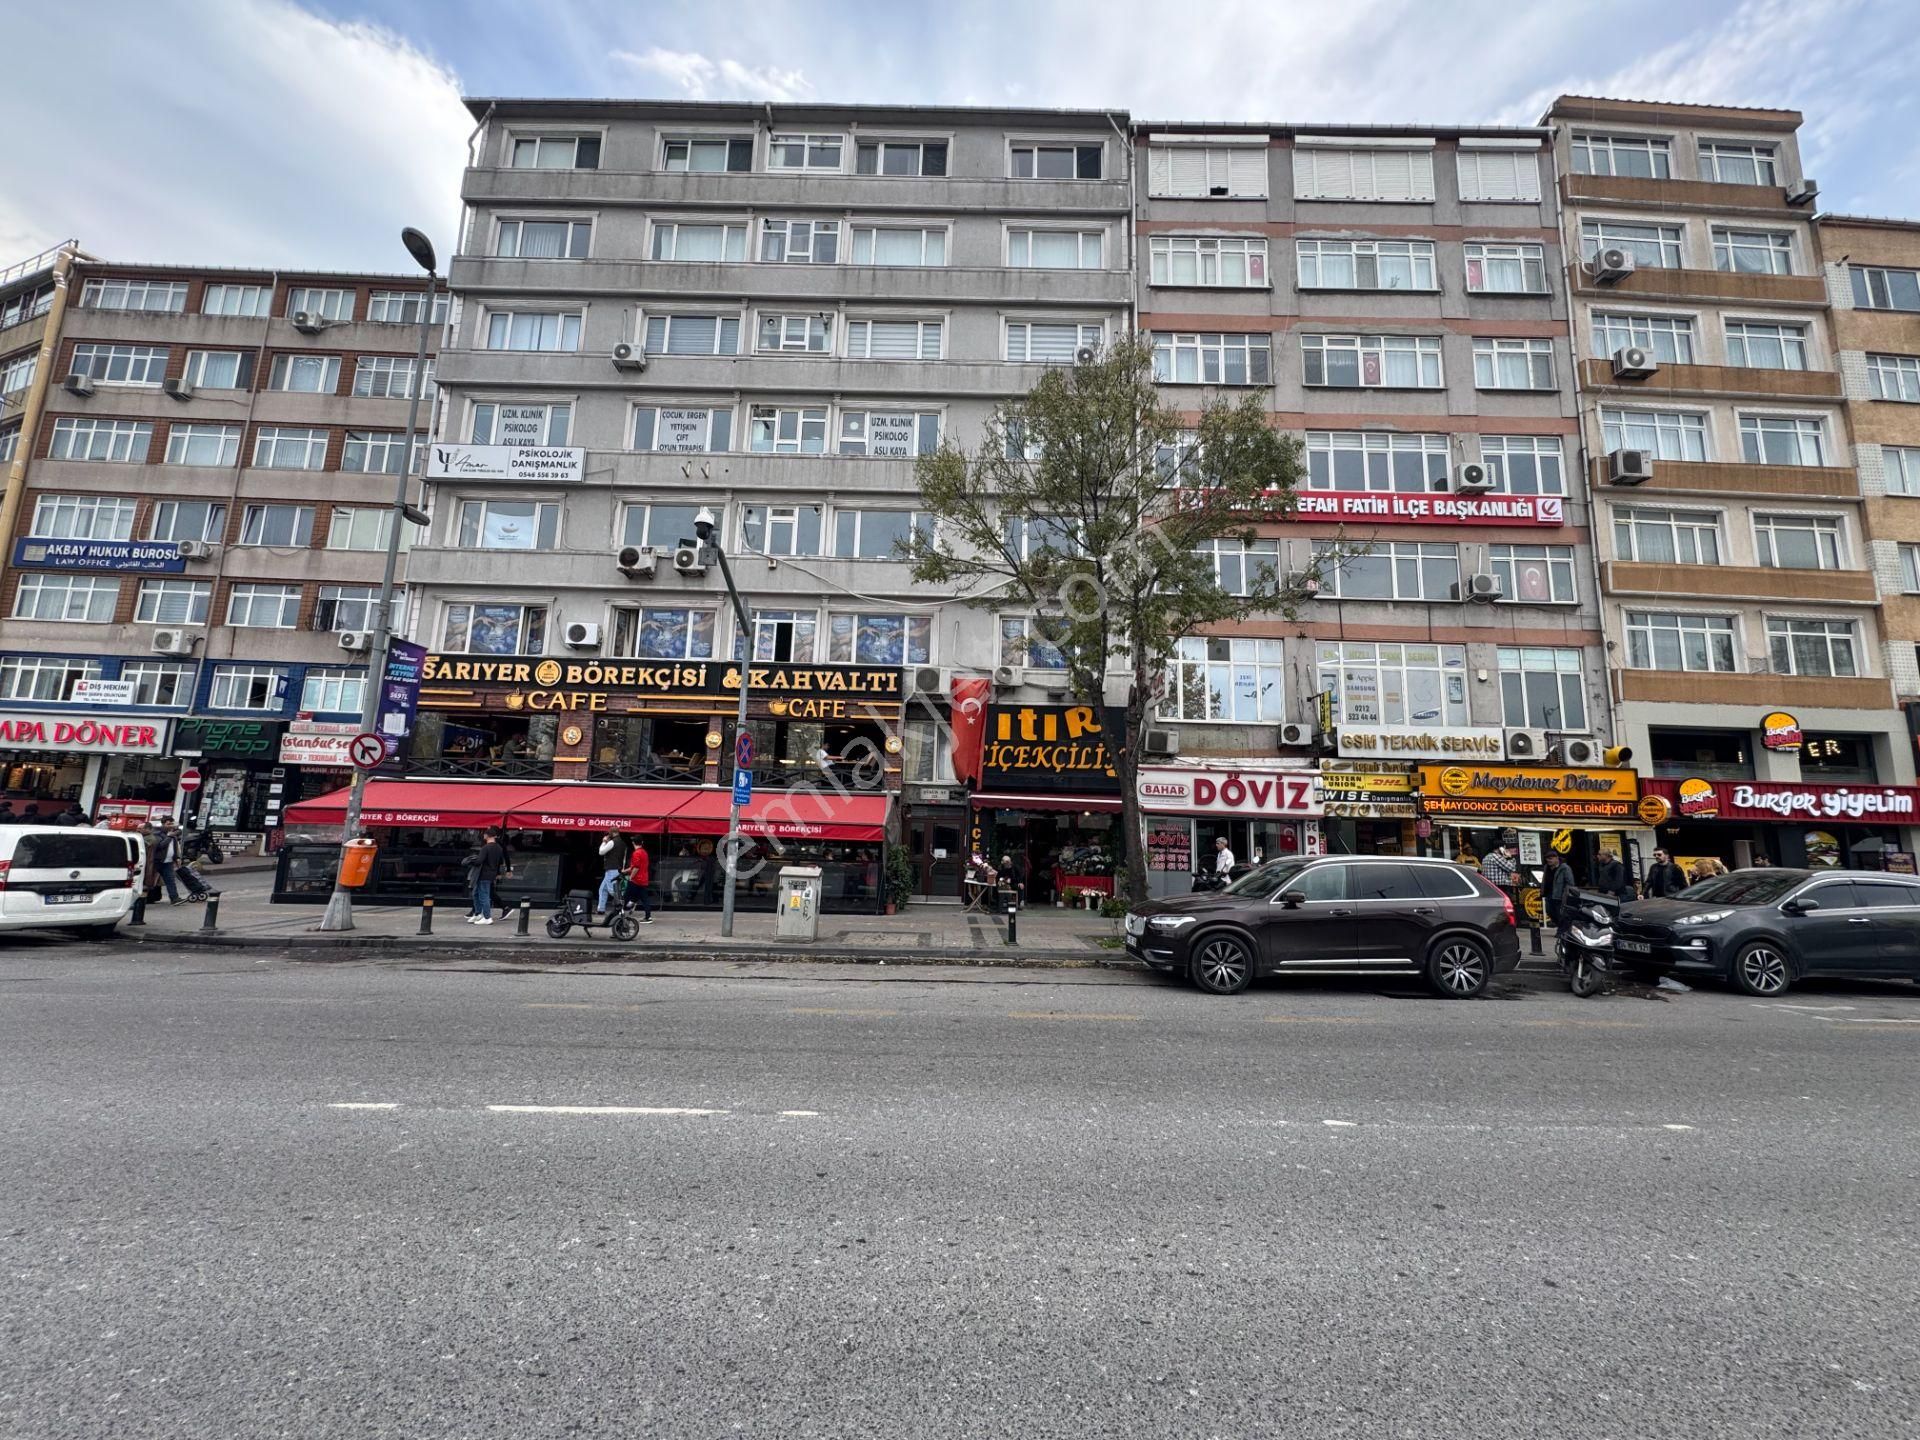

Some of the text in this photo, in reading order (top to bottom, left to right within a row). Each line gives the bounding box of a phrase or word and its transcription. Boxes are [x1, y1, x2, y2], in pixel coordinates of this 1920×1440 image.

[687, 412, 708, 420] ERGEN
[518, 449, 573, 459] PSİKOLOJİK
[874, 446, 907, 456] ASLI KAYA
[511, 460, 578, 471] DANIŞMANLIK
[1342, 495, 1389, 515] FATİH
[1393, 496, 1429, 519] İLÇE
[1433, 498, 1534, 520] BAŞKANLIĞI
[47, 544, 86, 556] AKBAY
[88, 545, 130, 558] HUKUK
[78, 558, 111, 567] OFFICE
[421, 661, 531, 683] SARIYER
[566, 661, 707, 691] BÖREKÇİSİ
[747, 669, 898, 692] KAHVALTI
[527, 691, 608, 711] CAFE
[788, 698, 846, 718] CAFE
[53, 720, 158, 747] DÖNER
[1341, 733, 1500, 753] GSM TEKNİK SERVİS
[1471, 772, 1617, 794] Maydonoz Döner
[1145, 786, 1185, 796] BAHAR
[1193, 773, 1310, 810] DÖVİZ
[1324, 791, 1371, 801] WISE
[396, 813, 439, 823] BÖREKÇİSİ
[541, 814, 632, 828] SARIYER BÖREKÇİSİ
[736, 823, 765, 832] ARIYER
